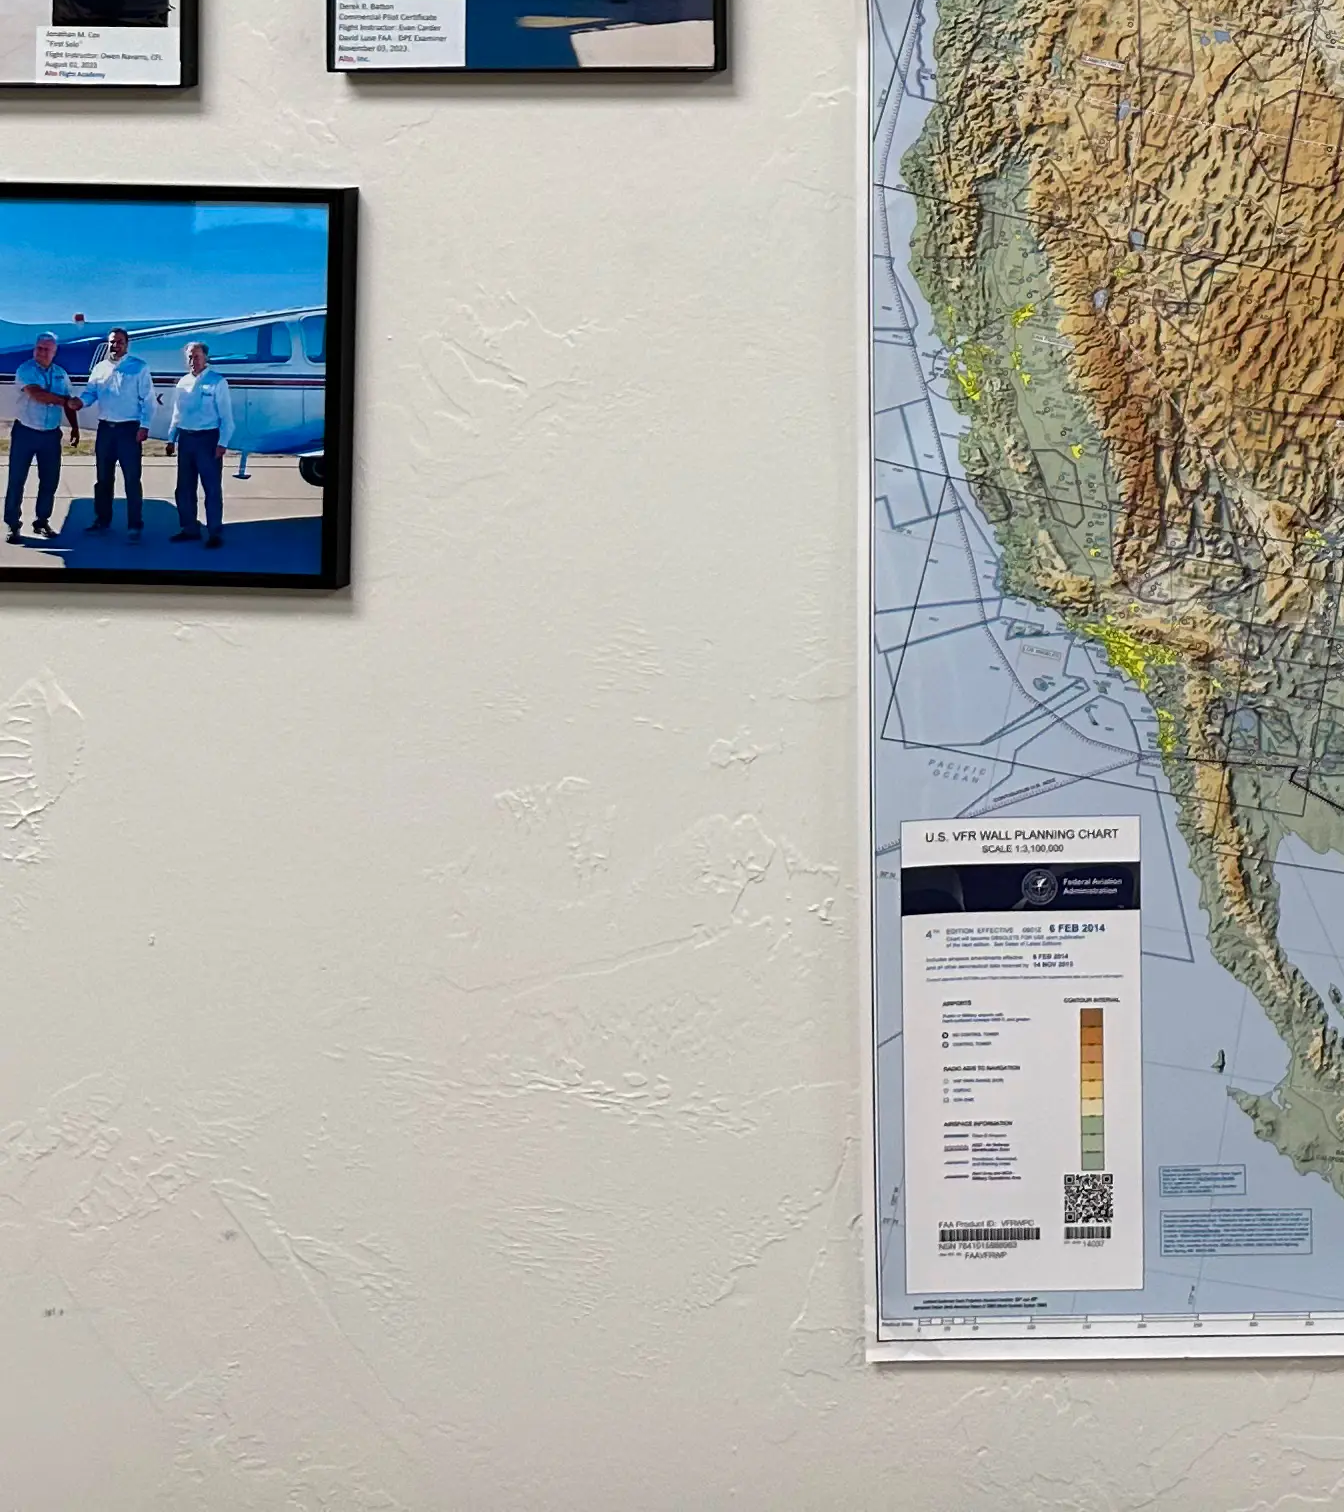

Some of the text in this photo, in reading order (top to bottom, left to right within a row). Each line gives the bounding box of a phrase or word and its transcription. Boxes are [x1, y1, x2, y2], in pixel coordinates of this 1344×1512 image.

[928, 759, 986, 775] PACIFIC
[933, 769, 979, 783] OCEAN
[925, 828, 1119, 843] U.S. VFR WALL PLANNING CHART
[982, 844, 1064, 853] SCALE 1:3,100,000
[1063, 877, 1122, 886] Federal Aviation
[1063, 887, 1118, 895] Administration
[1050, 924, 1056, 933] 6
[1058, 924, 1079, 933] FEB
[1082, 924, 1105, 932] 2014
